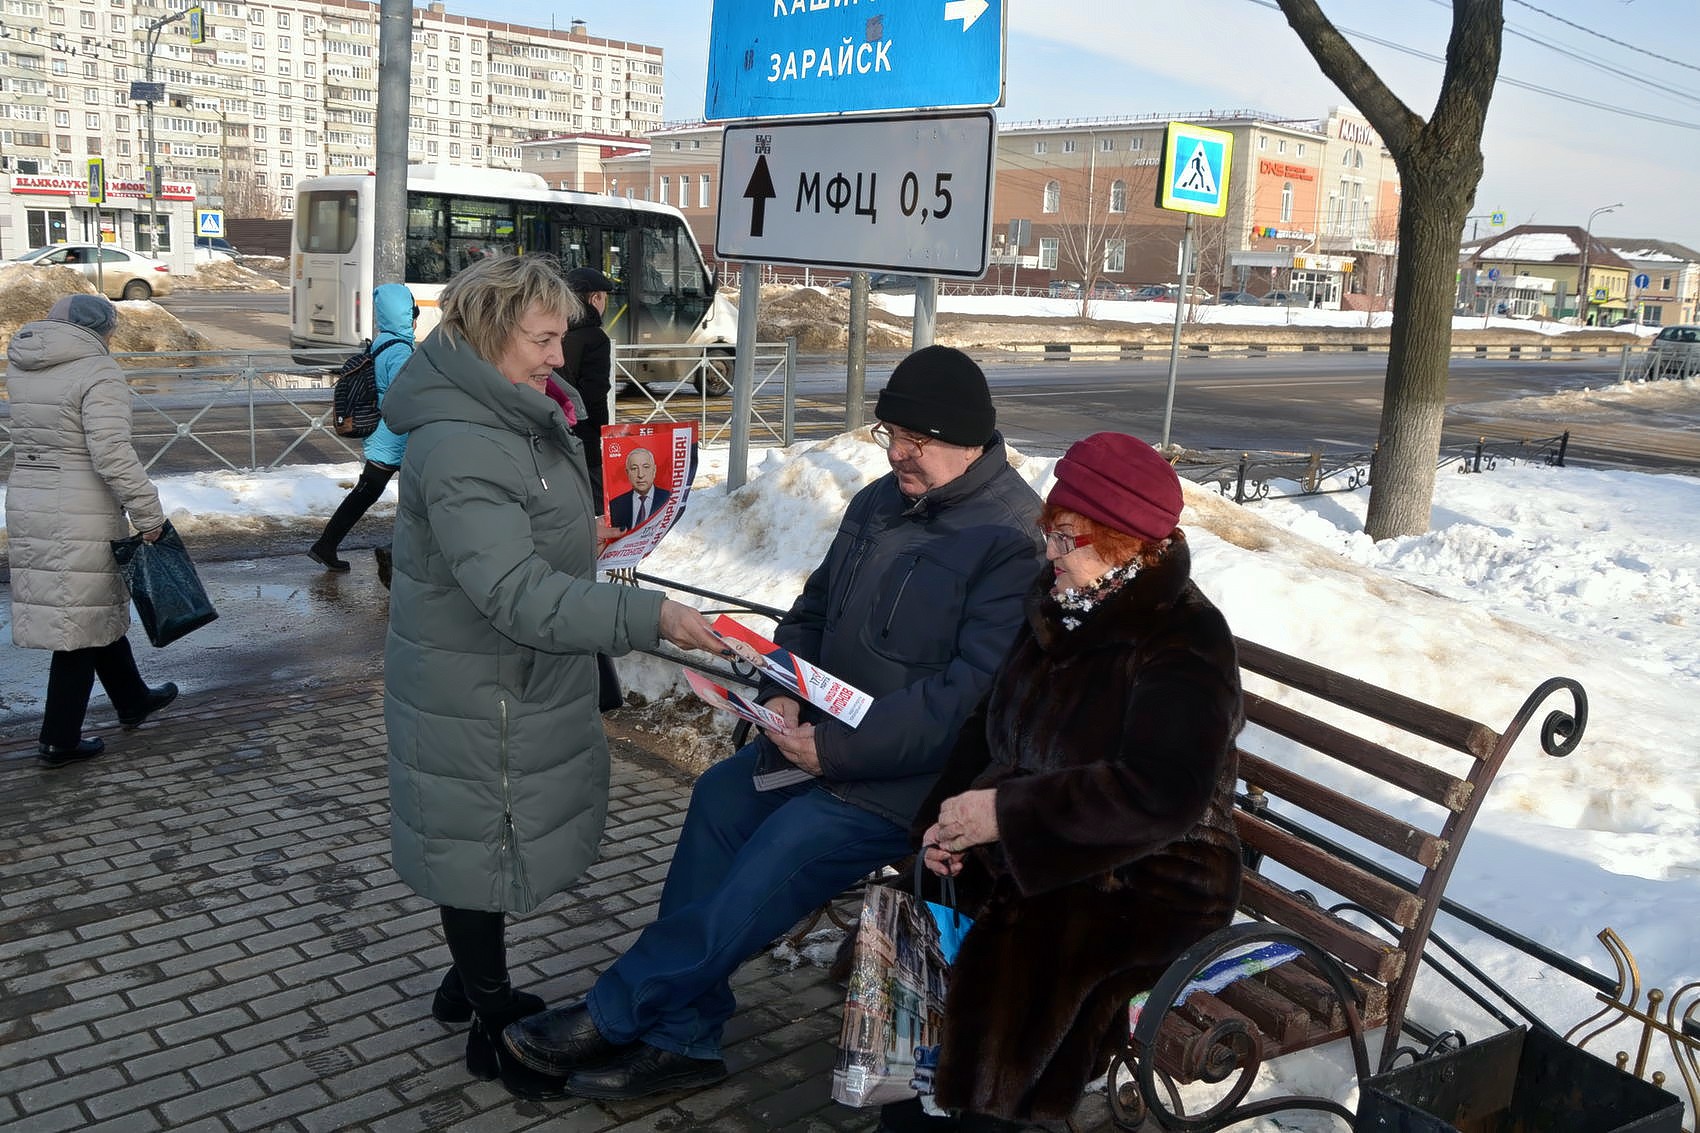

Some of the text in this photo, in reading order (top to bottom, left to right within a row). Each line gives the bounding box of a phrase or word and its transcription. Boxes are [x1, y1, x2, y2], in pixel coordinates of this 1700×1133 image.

[767, 37, 893, 82] ЗАРАЙСК
[795, 171, 953, 225] МФЦ 0,5
